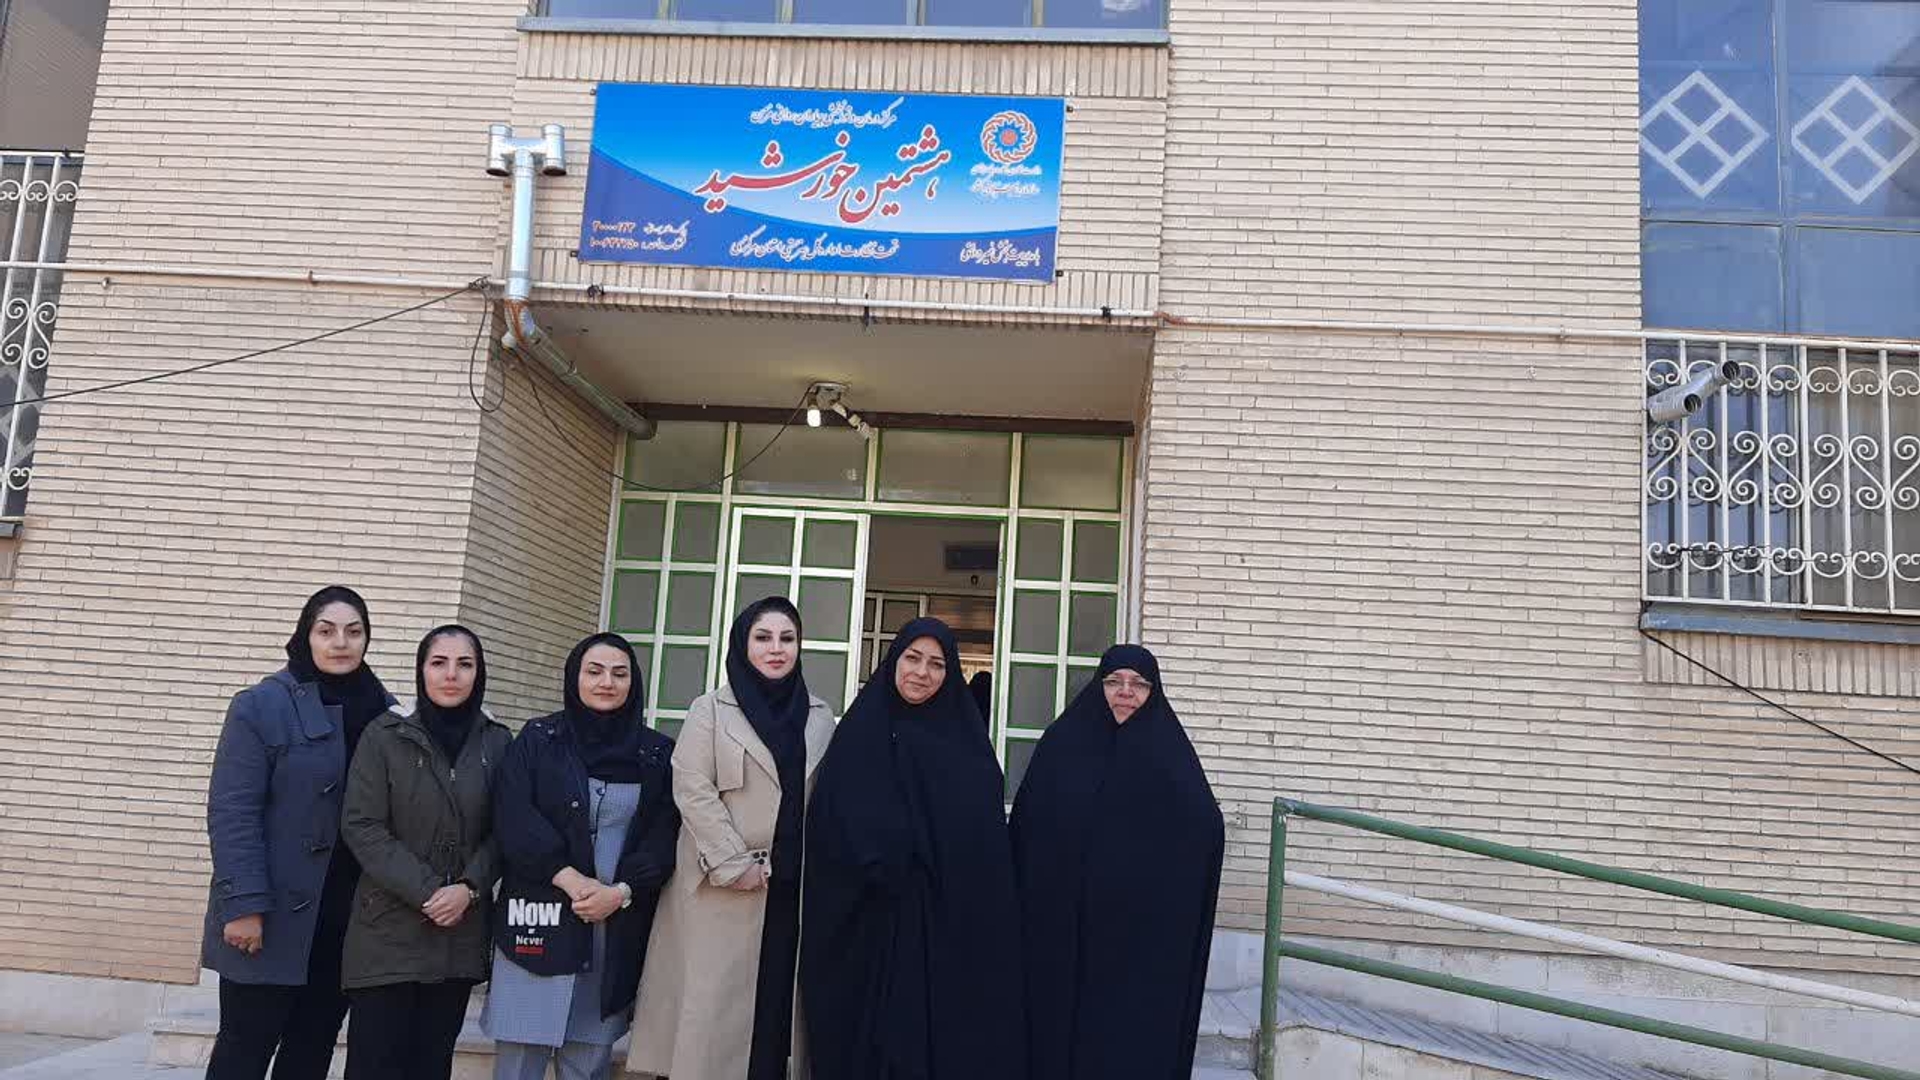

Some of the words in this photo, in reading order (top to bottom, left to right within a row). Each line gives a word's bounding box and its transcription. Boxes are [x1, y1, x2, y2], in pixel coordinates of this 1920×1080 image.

[693, 131, 859, 212] خورشید
[838, 125, 950, 223] هشتمین
[516, 935, 544, 946] Never
